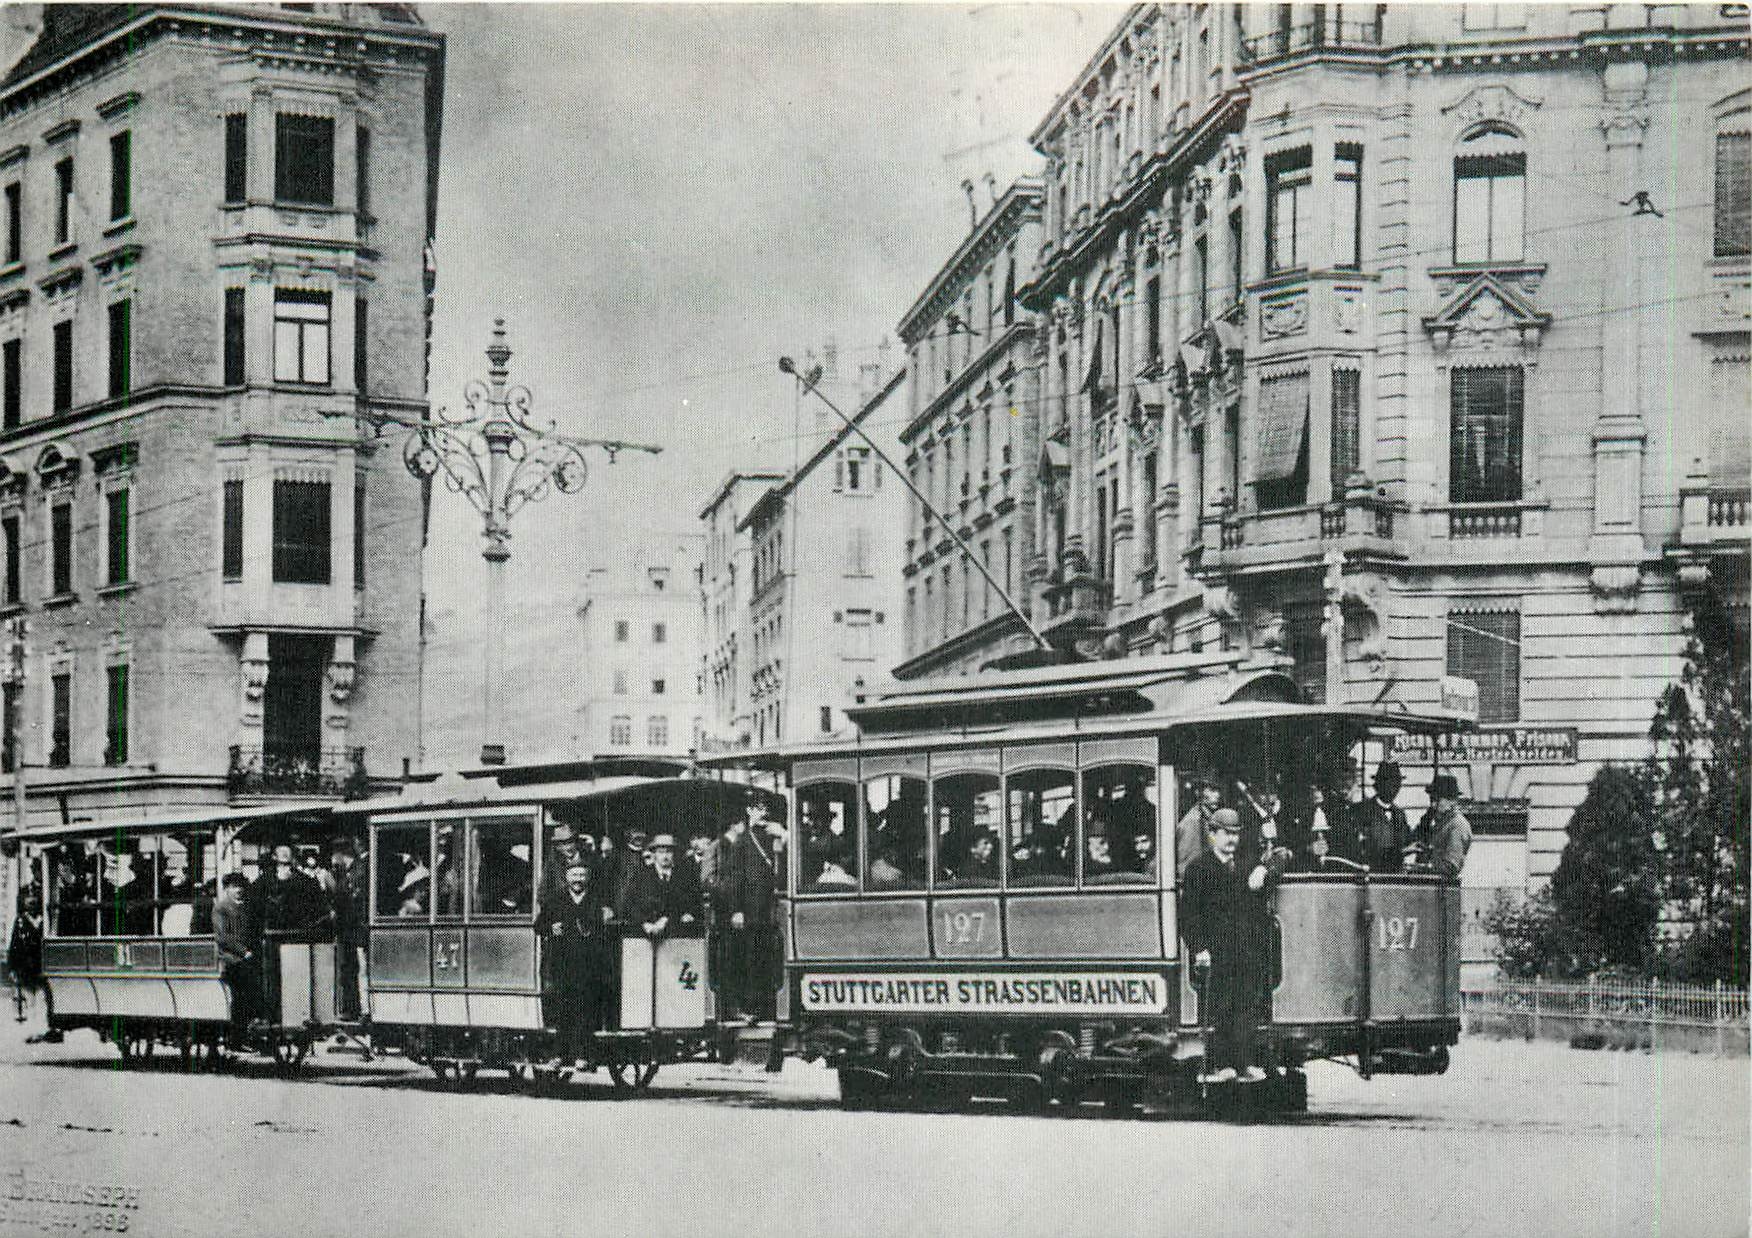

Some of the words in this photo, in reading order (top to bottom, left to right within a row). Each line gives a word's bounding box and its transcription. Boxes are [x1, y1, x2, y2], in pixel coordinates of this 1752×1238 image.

[944, 911, 986, 943] 127
[1379, 916, 1418, 949] 127
[679, 960, 698, 990] 4
[808, 979, 950, 1004] STUTTGARTER
[957, 979, 1157, 1005] STRASSENBAHNEN
